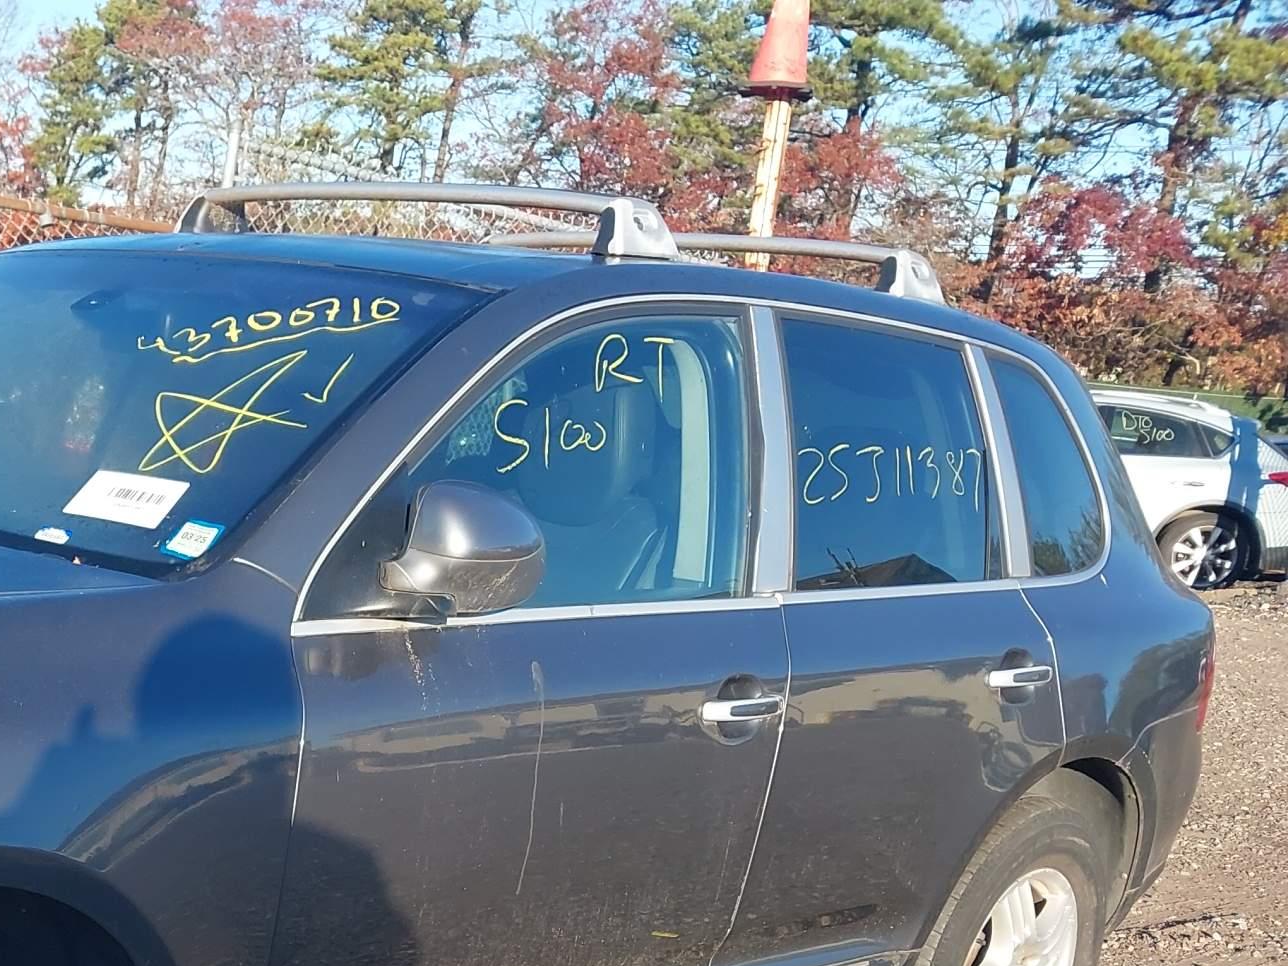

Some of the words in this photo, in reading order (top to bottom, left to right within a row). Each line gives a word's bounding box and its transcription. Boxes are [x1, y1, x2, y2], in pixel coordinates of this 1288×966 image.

[137, 297, 401, 355] 43700710
[594, 333, 675, 403] RT
[494, 399, 607, 473] S100
